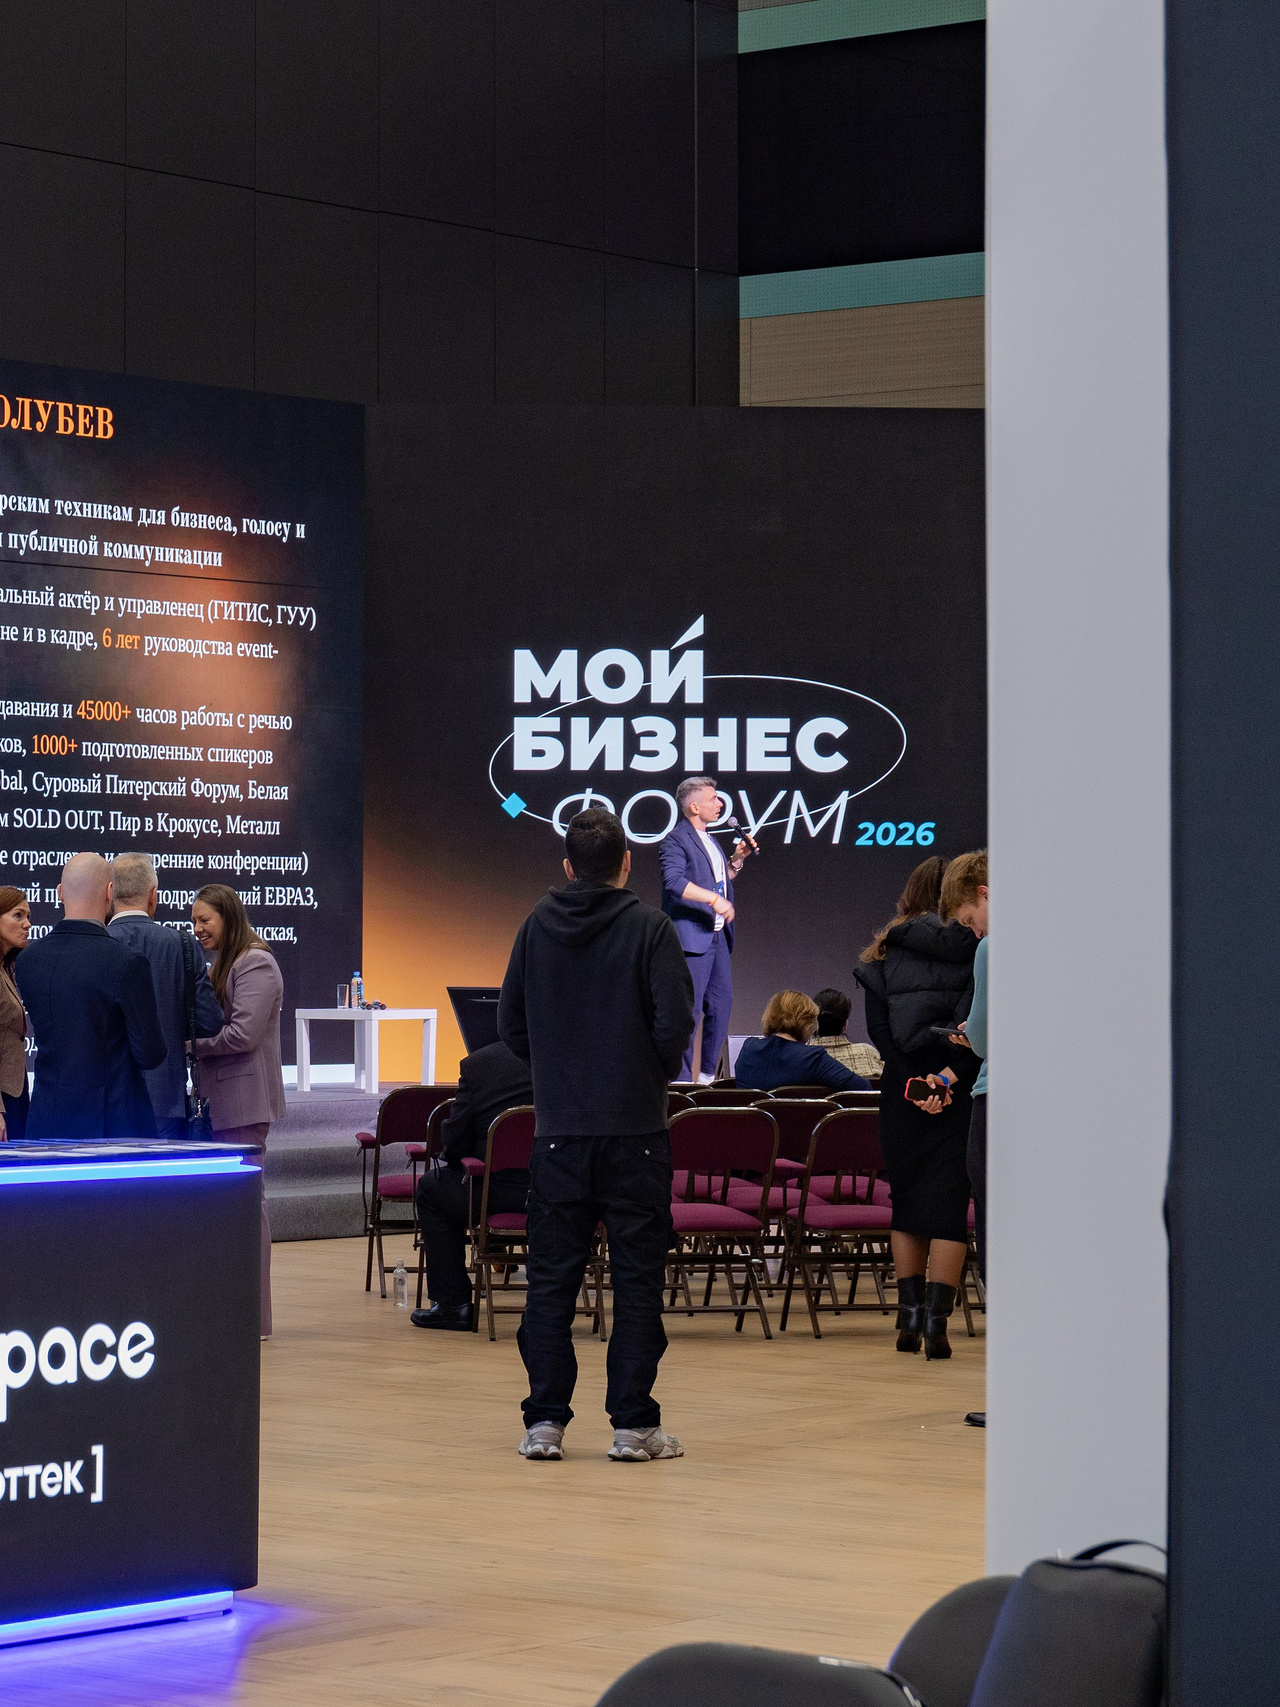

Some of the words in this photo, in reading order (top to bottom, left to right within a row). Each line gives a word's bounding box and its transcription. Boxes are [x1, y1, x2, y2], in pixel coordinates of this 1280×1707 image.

[54, 499, 134, 522] техникам
[137, 507, 167, 528] для
[170, 505, 238, 537] бизнеса,
[241, 518, 292, 543] голосу
[295, 523, 306, 539] и
[7, 529, 99, 556] публичной
[103, 541, 223, 569] коммуникации
[58, 590, 101, 614] актёр
[103, 596, 115, 611] и
[118, 599, 204, 623] управленец
[207, 599, 273, 627] (ГИТИС,
[276, 604, 317, 632] ГУУ)
[22, 626, 34, 642] и
[36, 628, 47, 643] в
[50, 628, 98, 652] кадре,
[102, 627, 112, 648] 6
[115, 633, 141, 650] лет
[143, 635, 234, 659] руководства
[236, 641, 278, 660] event-
[514, 614, 704, 704] МОЙ
[62, 703, 73, 719] и
[76, 699, 132, 722] 45000+
[135, 707, 178, 724] часов
[180, 705, 234, 731] работы
[236, 713, 245, 728] с
[247, 710, 293, 734] речью
[32, 734, 78, 756] 1000+
[81, 741, 205, 763] подготовленных
[207, 747, 274, 768] спикеров
[513, 716, 849, 773] БИЗНЕС
[32, 771, 102, 798] Суровый
[105, 774, 187, 801] Питерский
[190, 777, 244, 804] Форум,
[247, 779, 289, 801] Белая
[13, 807, 61, 829] SOLD
[64, 809, 105, 834] OUT,
[109, 810, 141, 837] Пир
[144, 817, 154, 832] в
[156, 812, 222, 839] Крокусе,
[225, 814, 281, 836] Металл
[855, 821, 936, 846] 2026
[12, 850, 99, 871] отрасле
[207, 850, 309, 875] конференции)
[264, 886, 319, 910] ЕВРАЗ,
